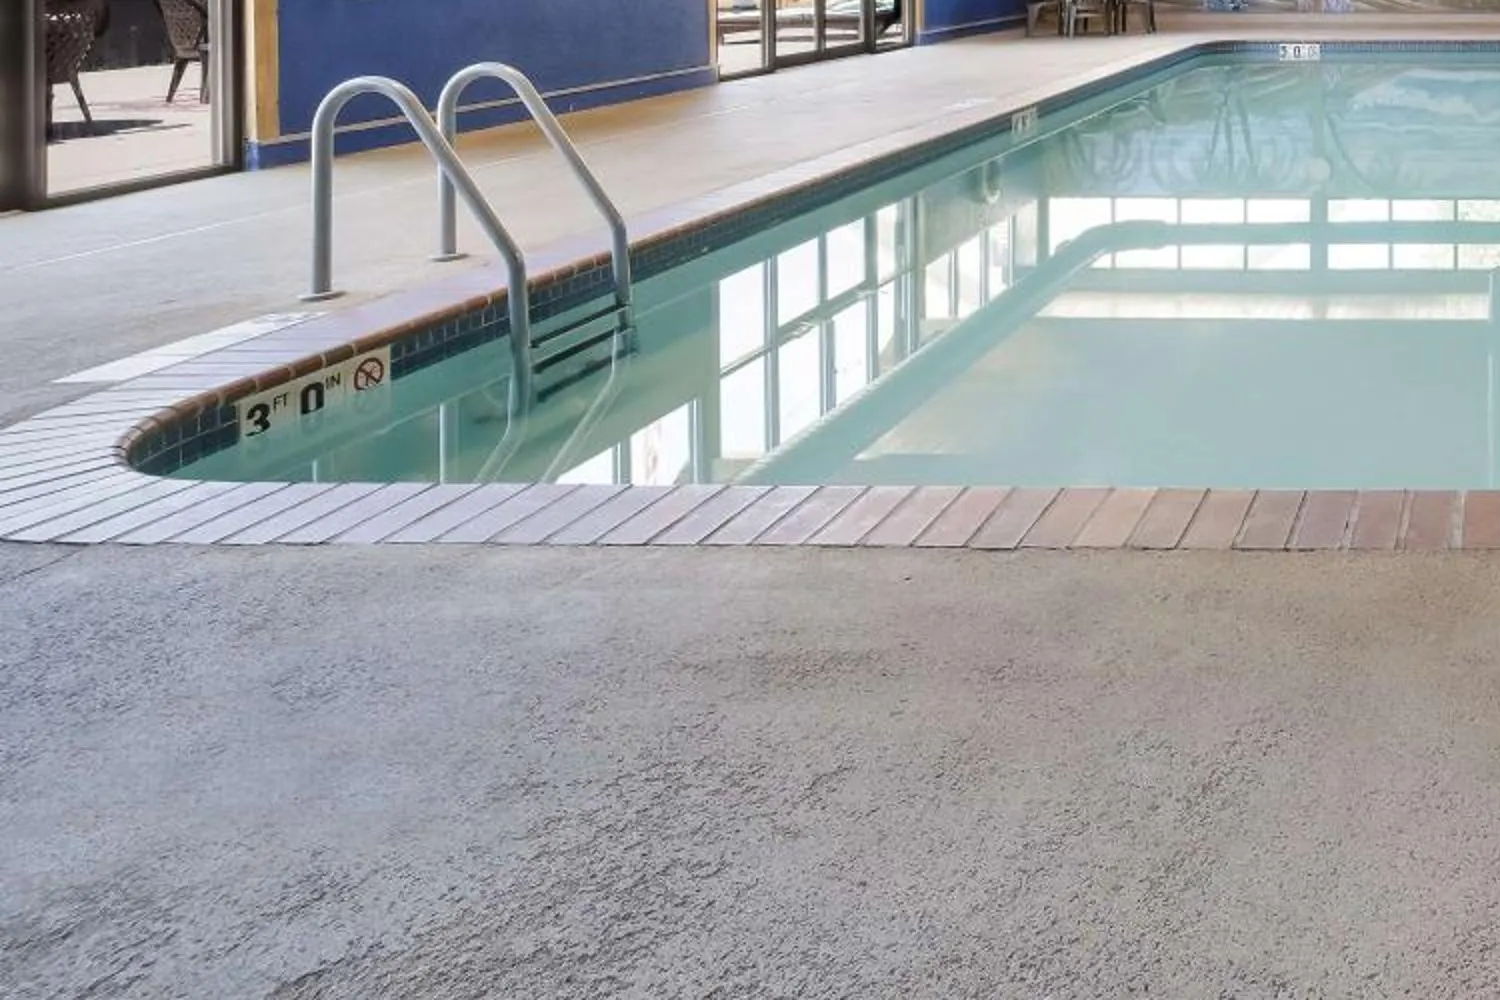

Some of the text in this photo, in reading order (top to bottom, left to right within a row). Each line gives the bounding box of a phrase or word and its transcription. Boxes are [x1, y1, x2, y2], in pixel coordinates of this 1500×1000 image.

[246, 373, 341, 437] 3 FT 0 IN
